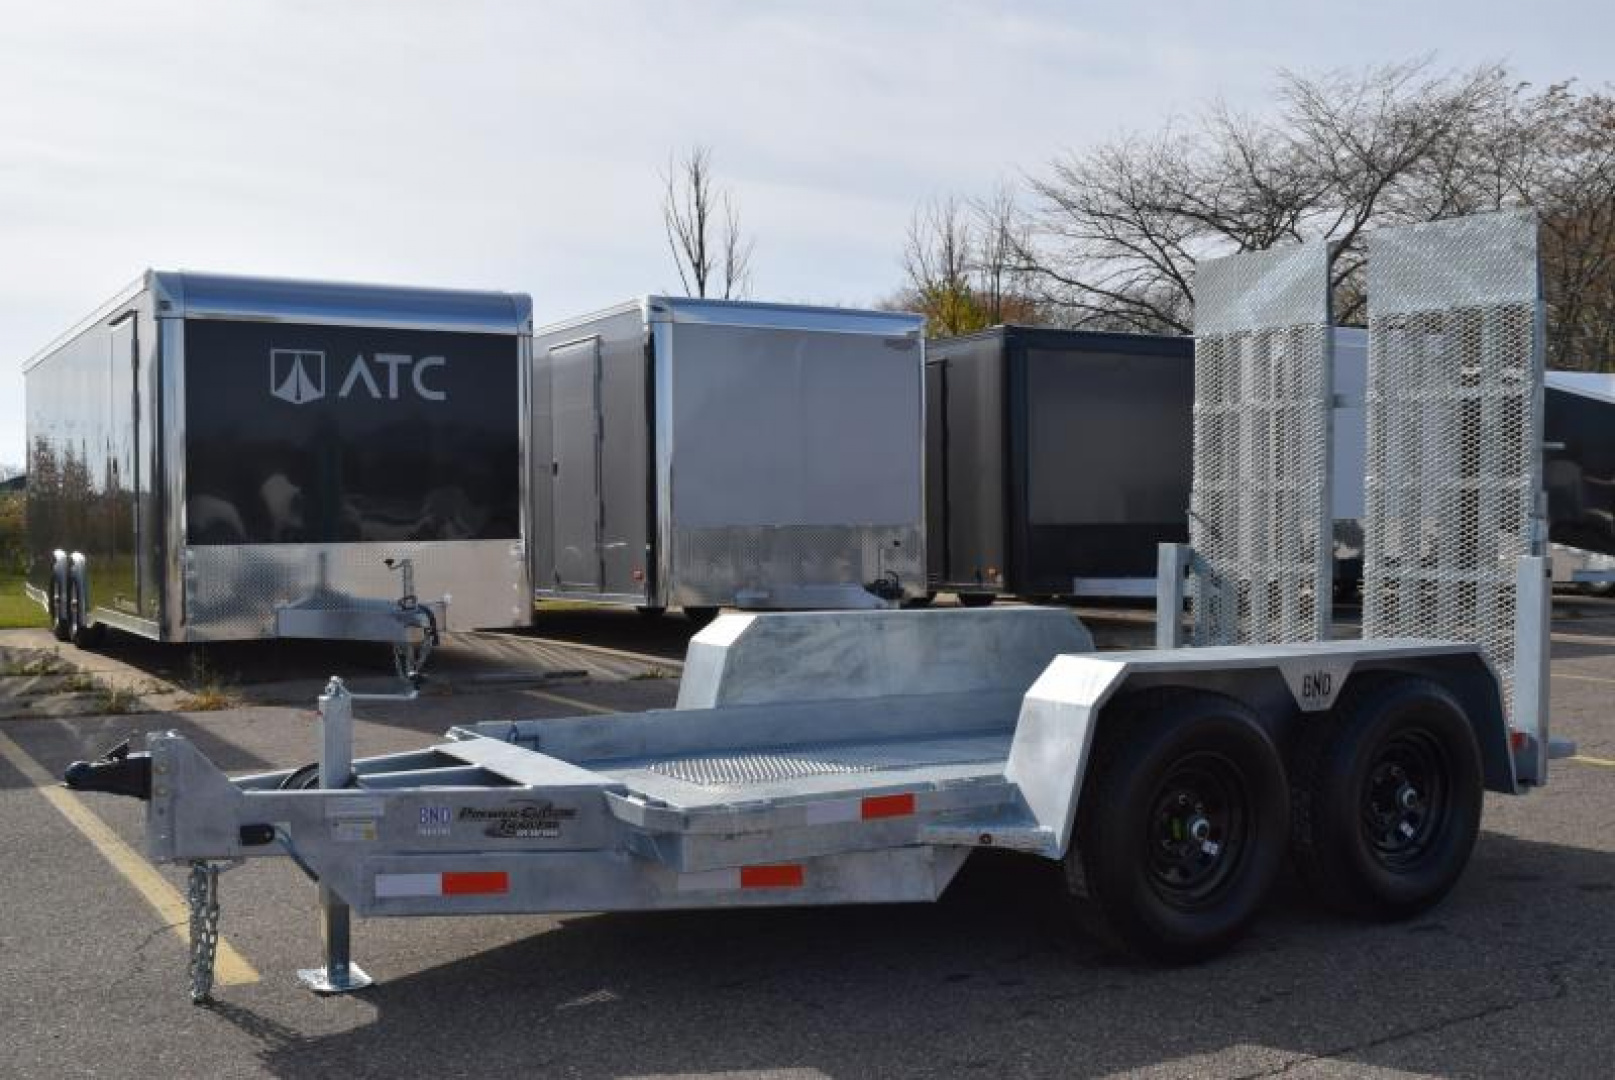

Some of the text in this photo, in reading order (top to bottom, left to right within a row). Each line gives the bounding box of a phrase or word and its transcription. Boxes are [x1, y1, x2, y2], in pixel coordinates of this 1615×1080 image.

[338, 354, 446, 401] ATC
[1303, 671, 1331, 697] BND
[419, 807, 451, 825] BND
